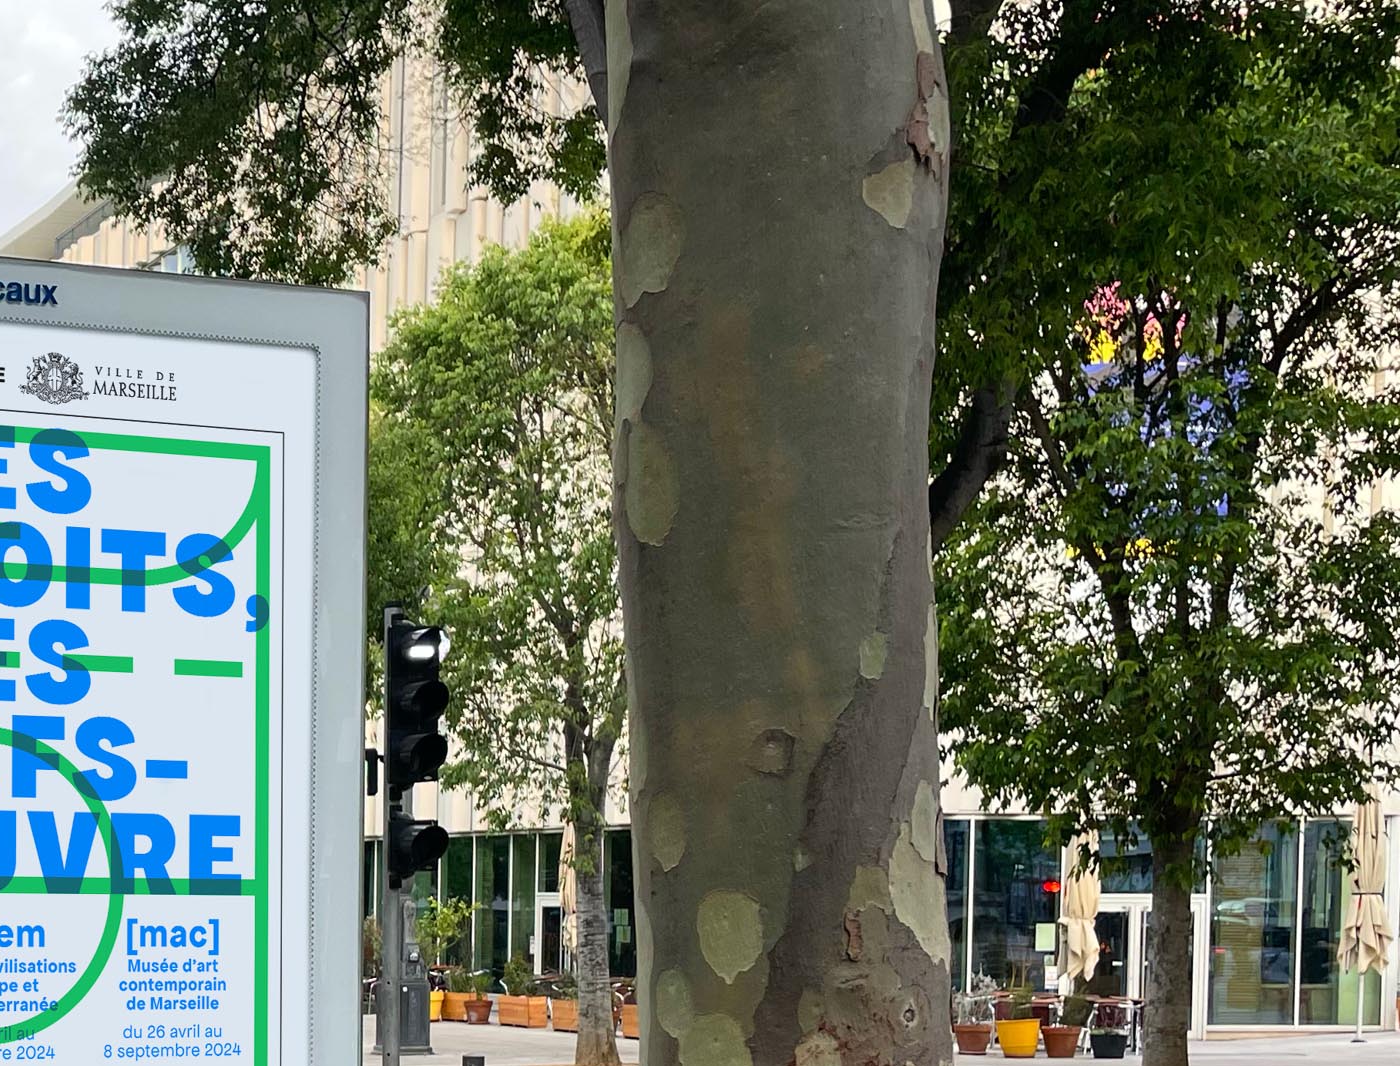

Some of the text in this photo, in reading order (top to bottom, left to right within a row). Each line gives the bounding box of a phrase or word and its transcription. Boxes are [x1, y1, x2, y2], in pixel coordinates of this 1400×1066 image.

[95, 366, 174, 382] VILLE DE
[93, 380, 176, 401] MARSEILLE
[127, 919, 219, 955] [mac]
[129, 959, 218, 972] Musée d'art
[23, 979, 38, 992] et
[119, 977, 226, 994] contemporain
[127, 996, 218, 1010] de Marseille
[16, 1027, 35, 1041] au
[123, 1024, 221, 1038] du 26 avril au
[17, 1046, 55, 1059] 2024
[104, 1043, 241, 1061] 8 septembre 2024
